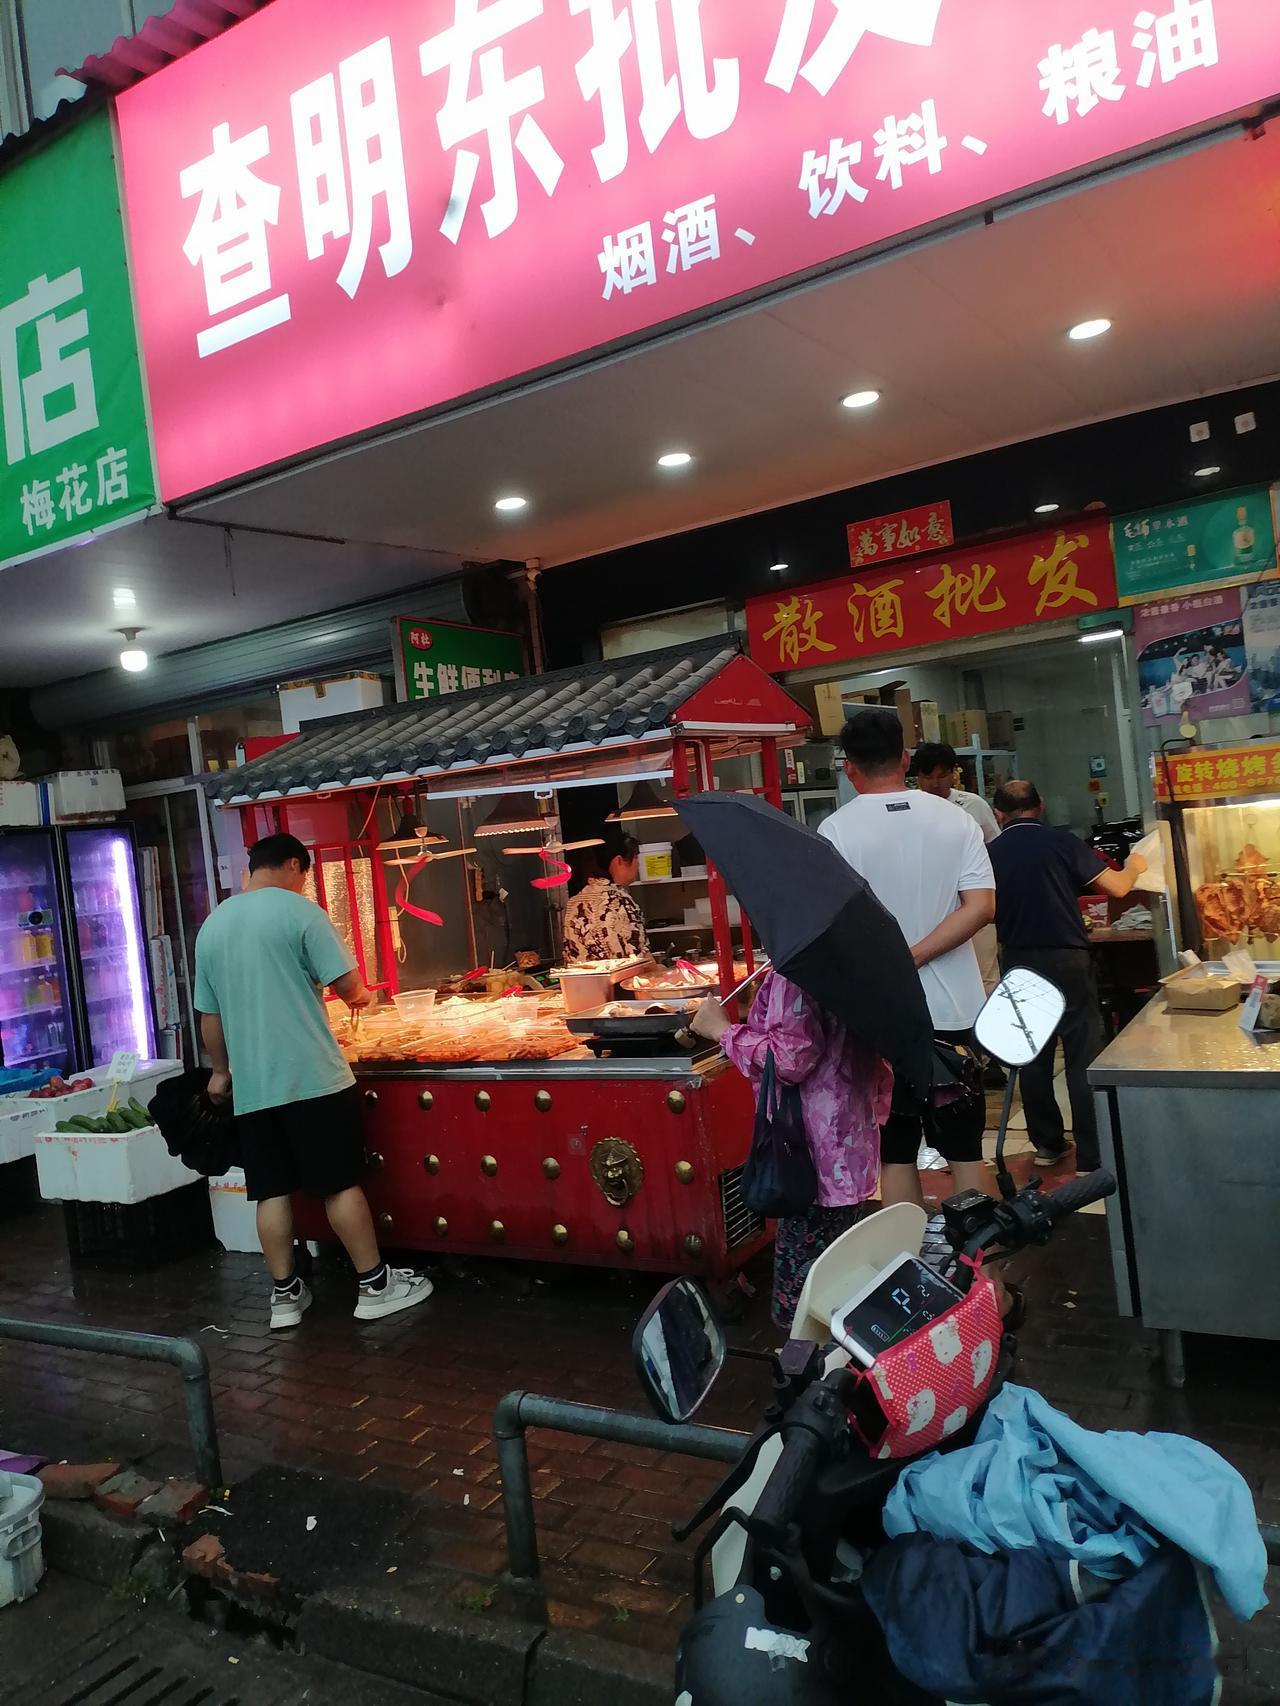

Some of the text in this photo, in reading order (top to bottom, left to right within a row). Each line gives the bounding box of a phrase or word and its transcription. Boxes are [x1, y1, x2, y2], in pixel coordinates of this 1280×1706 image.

[0, 267, 100, 465] 店
[20, 447, 130, 537] 梅花店
[763, 531, 1097, 665] 散酒批发
